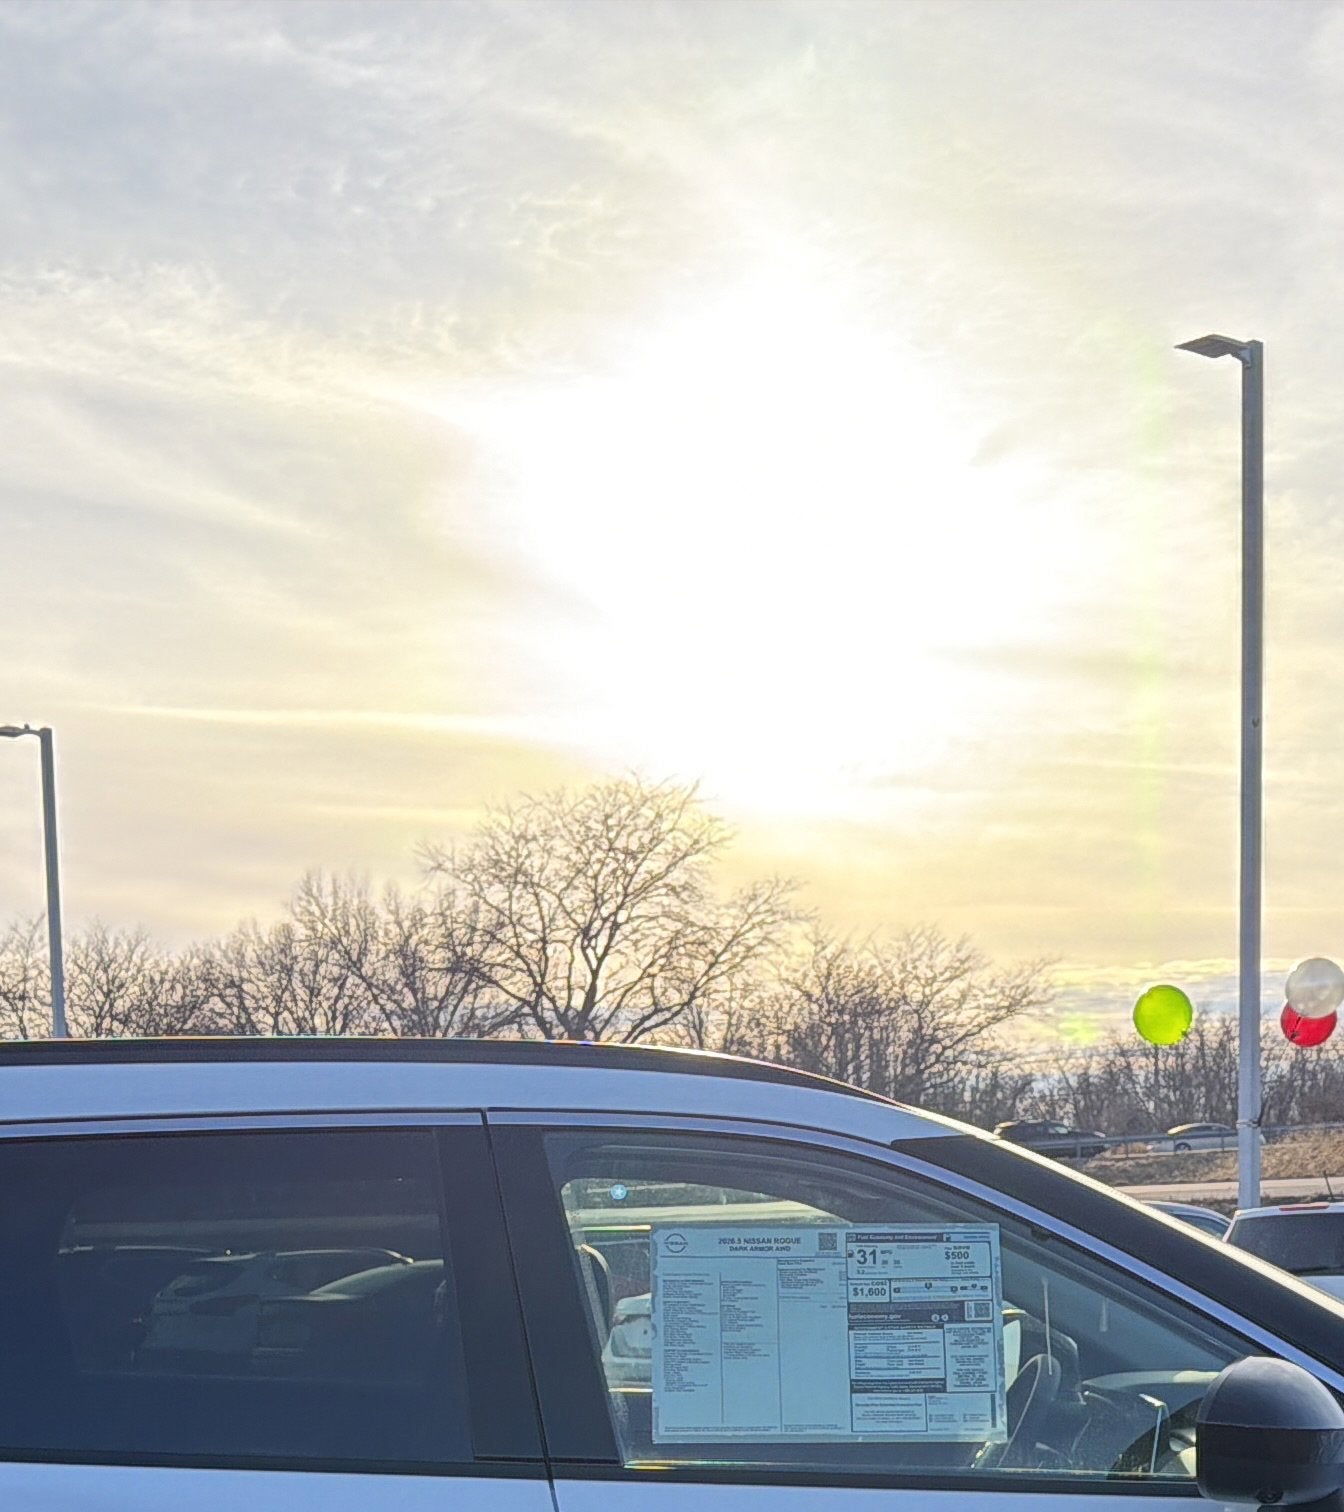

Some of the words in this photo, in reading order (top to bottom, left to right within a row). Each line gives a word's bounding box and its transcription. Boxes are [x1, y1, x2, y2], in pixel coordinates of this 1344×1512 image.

[743, 1237, 772, 1245] NISSAN
[773, 1237, 802, 1245] ROGUE
[856, 1249, 877, 1265] 31
[944, 1250, 970, 1261] $500
